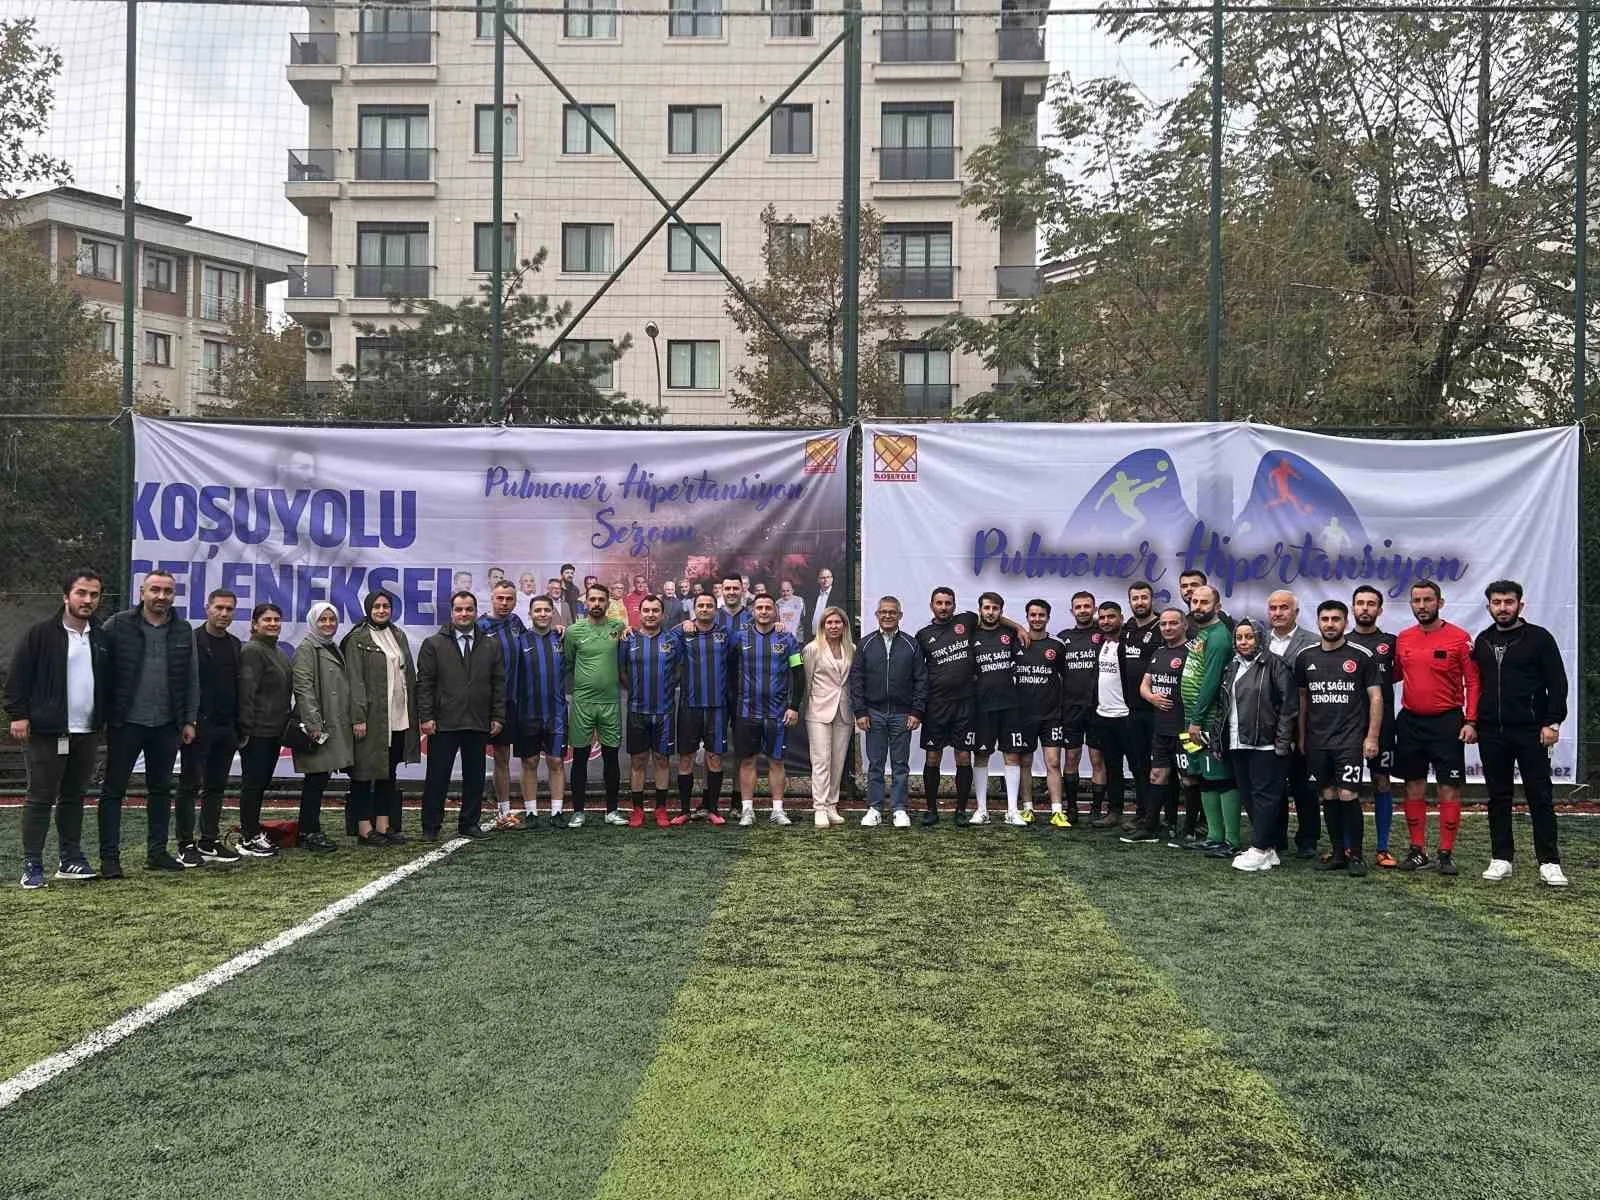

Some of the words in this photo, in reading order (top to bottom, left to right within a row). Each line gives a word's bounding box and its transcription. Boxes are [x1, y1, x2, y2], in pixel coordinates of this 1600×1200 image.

[484, 466, 612, 503] Pulmoner
[619, 463, 806, 512] Hipertansiyon
[133, 481, 417, 560] KOŞUYOLU
[974, 527, 1168, 583] Pulmoner
[1176, 519, 1469, 597] Hipertansiyon
[1327, 679, 1355, 691] SAĞLIK
[1312, 692, 1349, 704] SENDİKASI
[1011, 732, 1022, 747] 13
[1175, 753, 1189, 769] 18
[1342, 764, 1361, 783] 23
